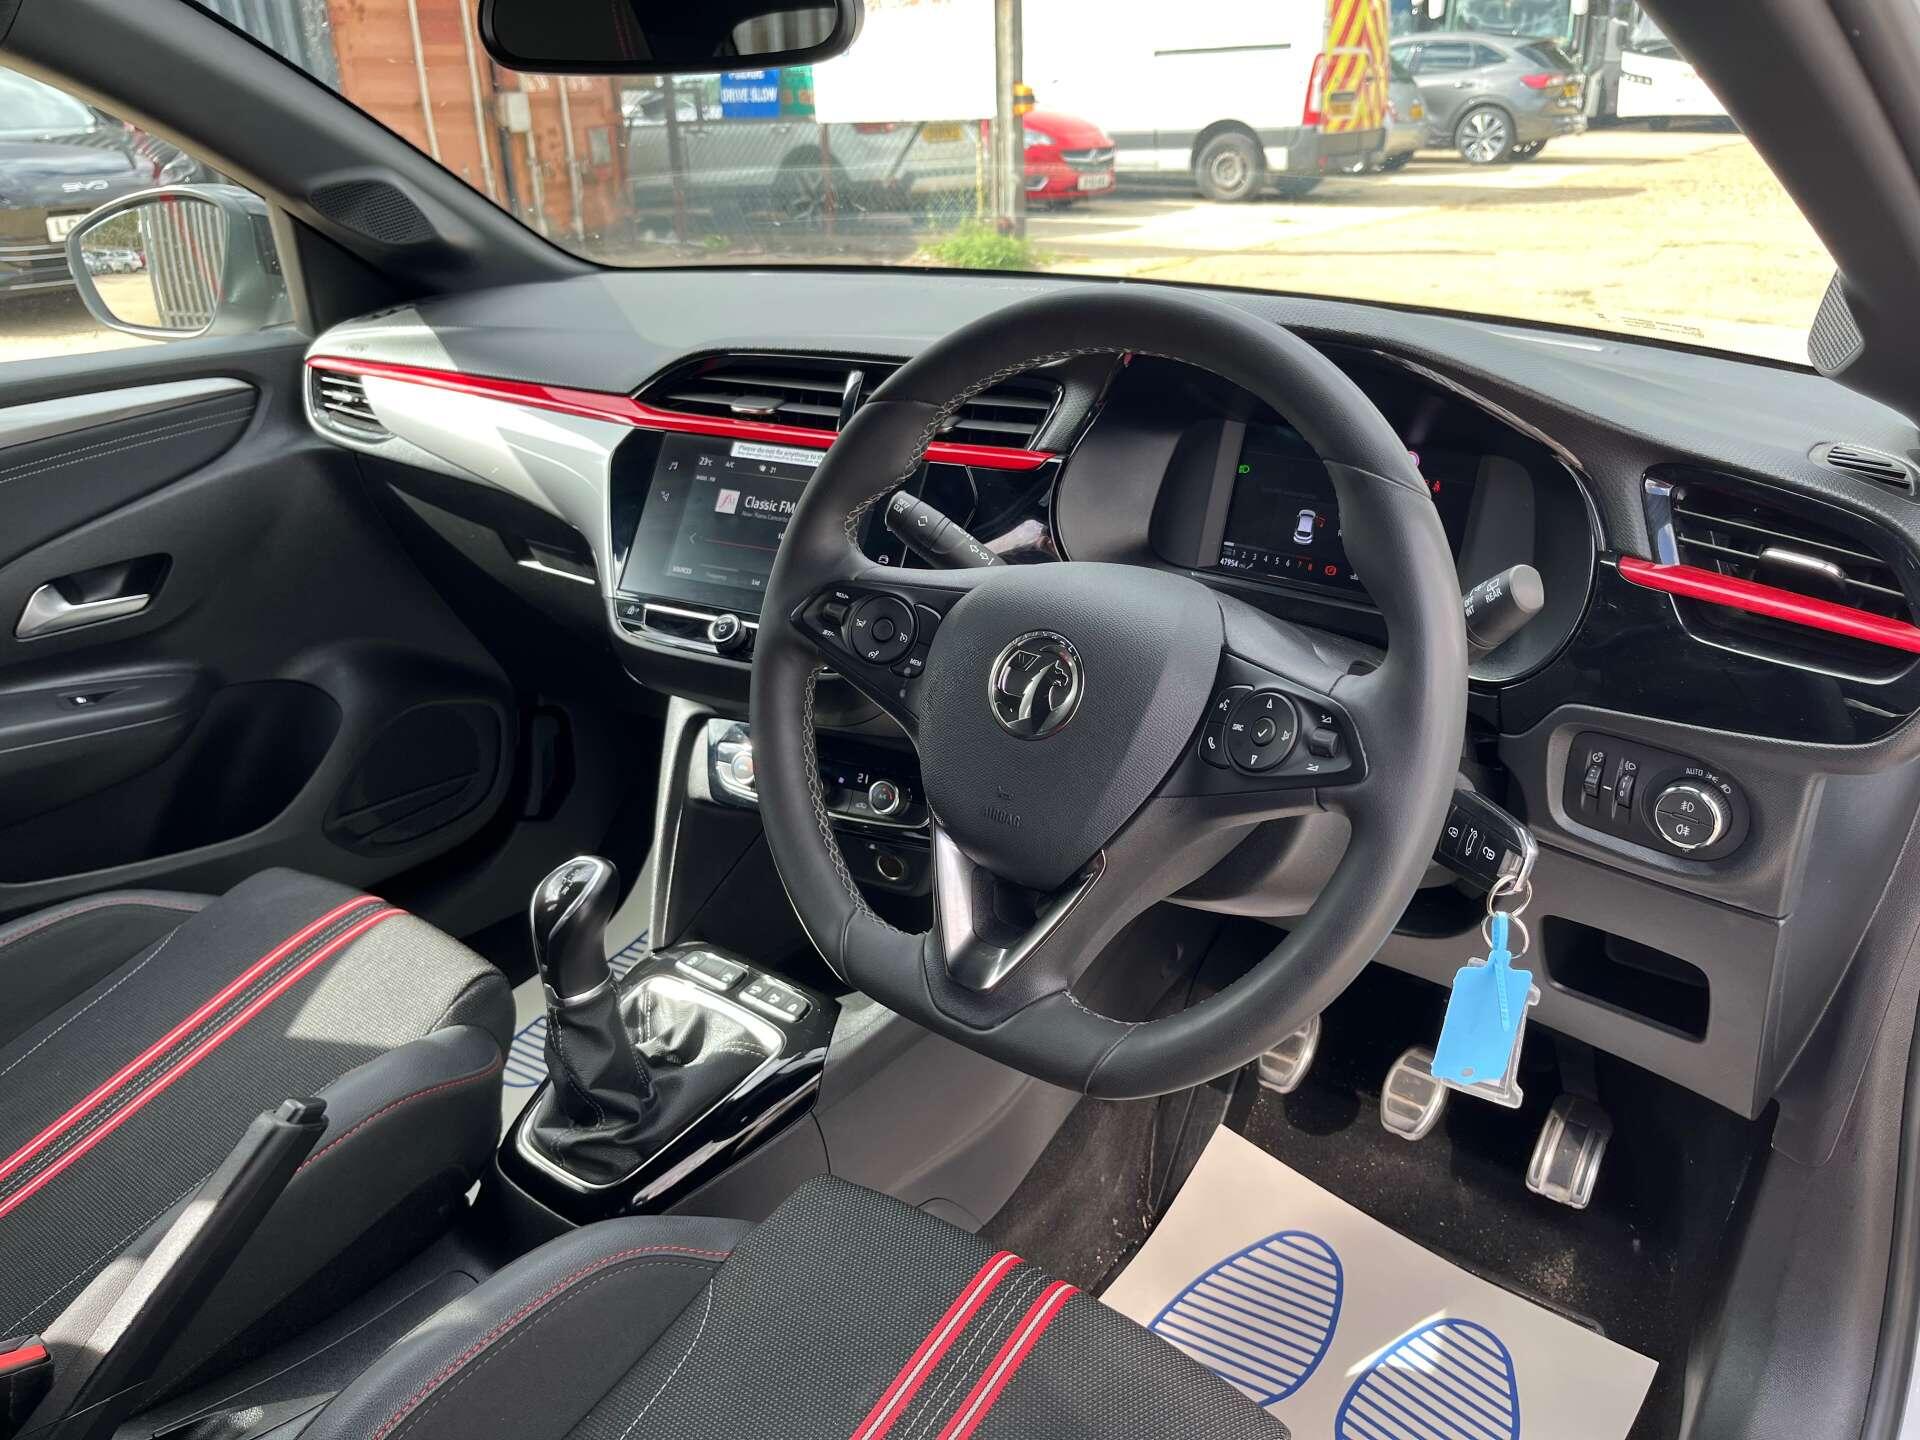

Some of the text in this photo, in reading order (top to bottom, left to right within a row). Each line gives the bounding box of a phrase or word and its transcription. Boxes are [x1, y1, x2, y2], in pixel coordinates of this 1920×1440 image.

[721, 87, 777, 103] DRIVE SLOW
[745, 496, 795, 513] Classic FM
[1485, 587, 1503, 604] REAR
[909, 658, 922, 667] MEM
[1685, 767, 1704, 777] AUTO
